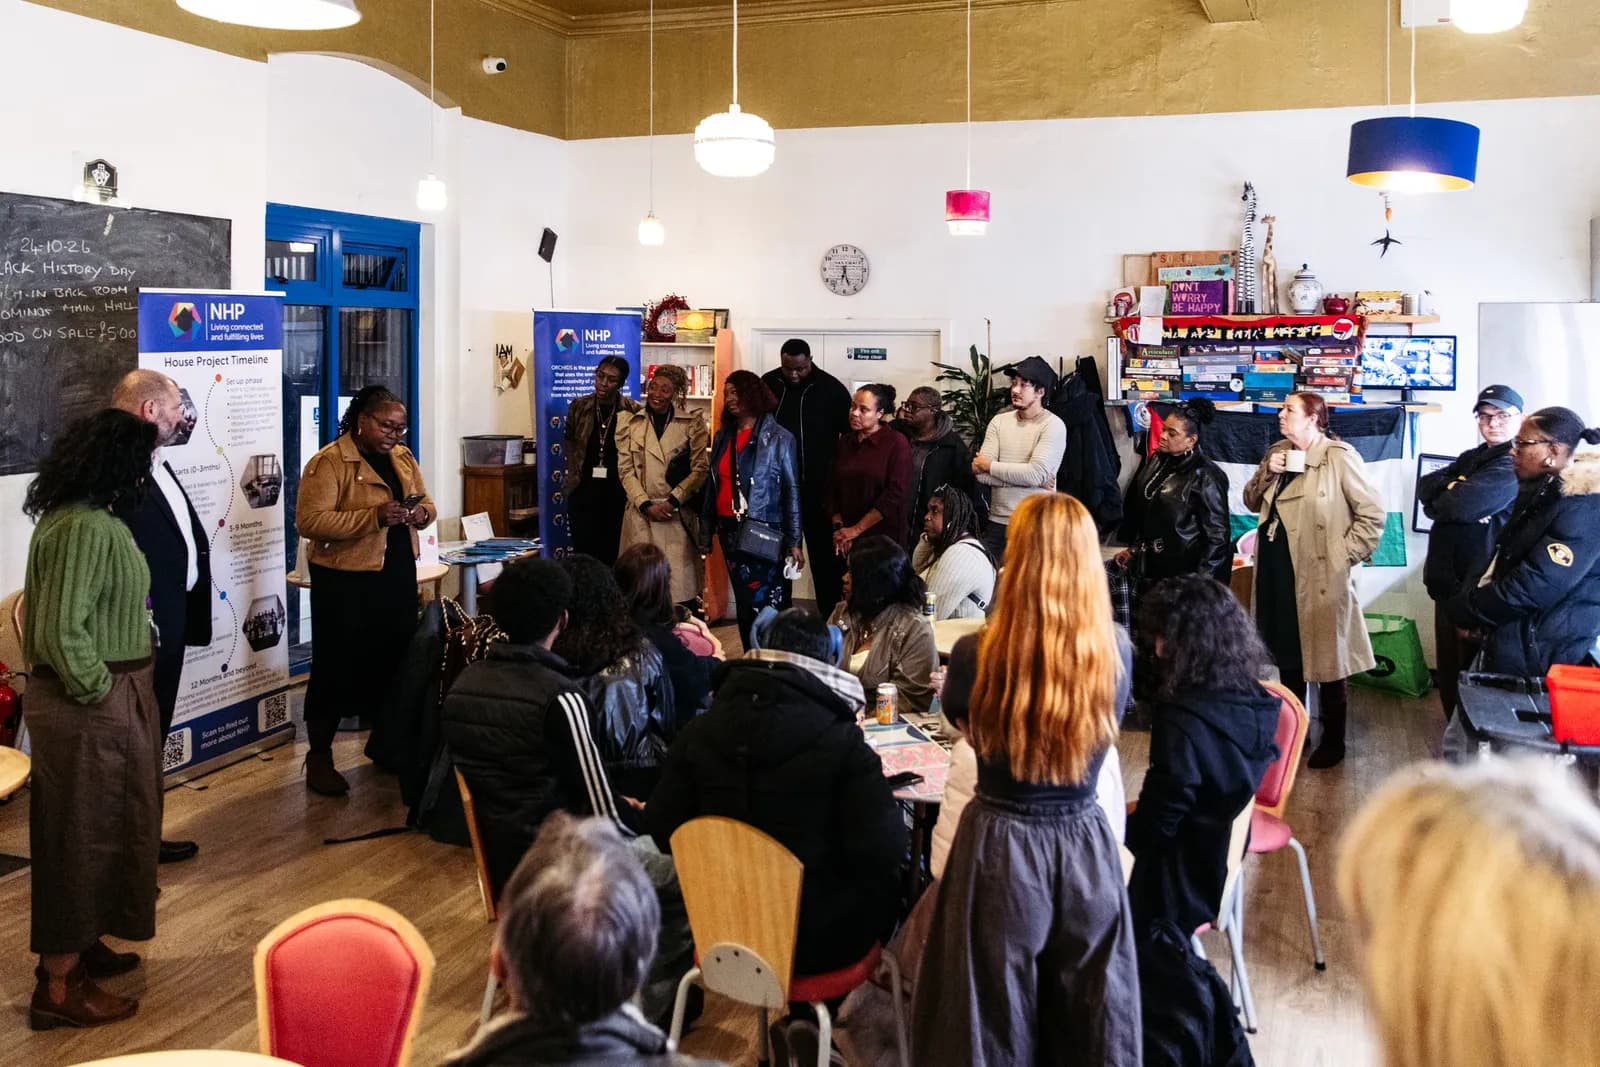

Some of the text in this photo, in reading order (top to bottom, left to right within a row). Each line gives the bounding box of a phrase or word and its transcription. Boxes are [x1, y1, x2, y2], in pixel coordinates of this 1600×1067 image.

[43, 261, 102, 279] HISTORY
[109, 265, 136, 282] DAY
[53, 287, 87, 297] BACK
[93, 286, 128, 297] ROOM
[62, 304, 95, 314] MAIN
[104, 300, 138, 312] HALL
[210, 303, 246, 321] NHP
[1171, 302, 1221, 313] BE HAPPY
[32, 327, 52, 339] ON
[57, 326, 97, 340] SALE
[210, 323, 264, 332] Living connected
[210, 333, 265, 342] and fulfilling lives
[585, 329, 611, 341] NHP
[164, 354, 269, 368] House Project Timeline
[191, 662, 257, 690] 12 Months and beyond
[200, 738, 218, 751] more
[218, 731, 236, 743] about
[202, 729, 217, 740] Scan
